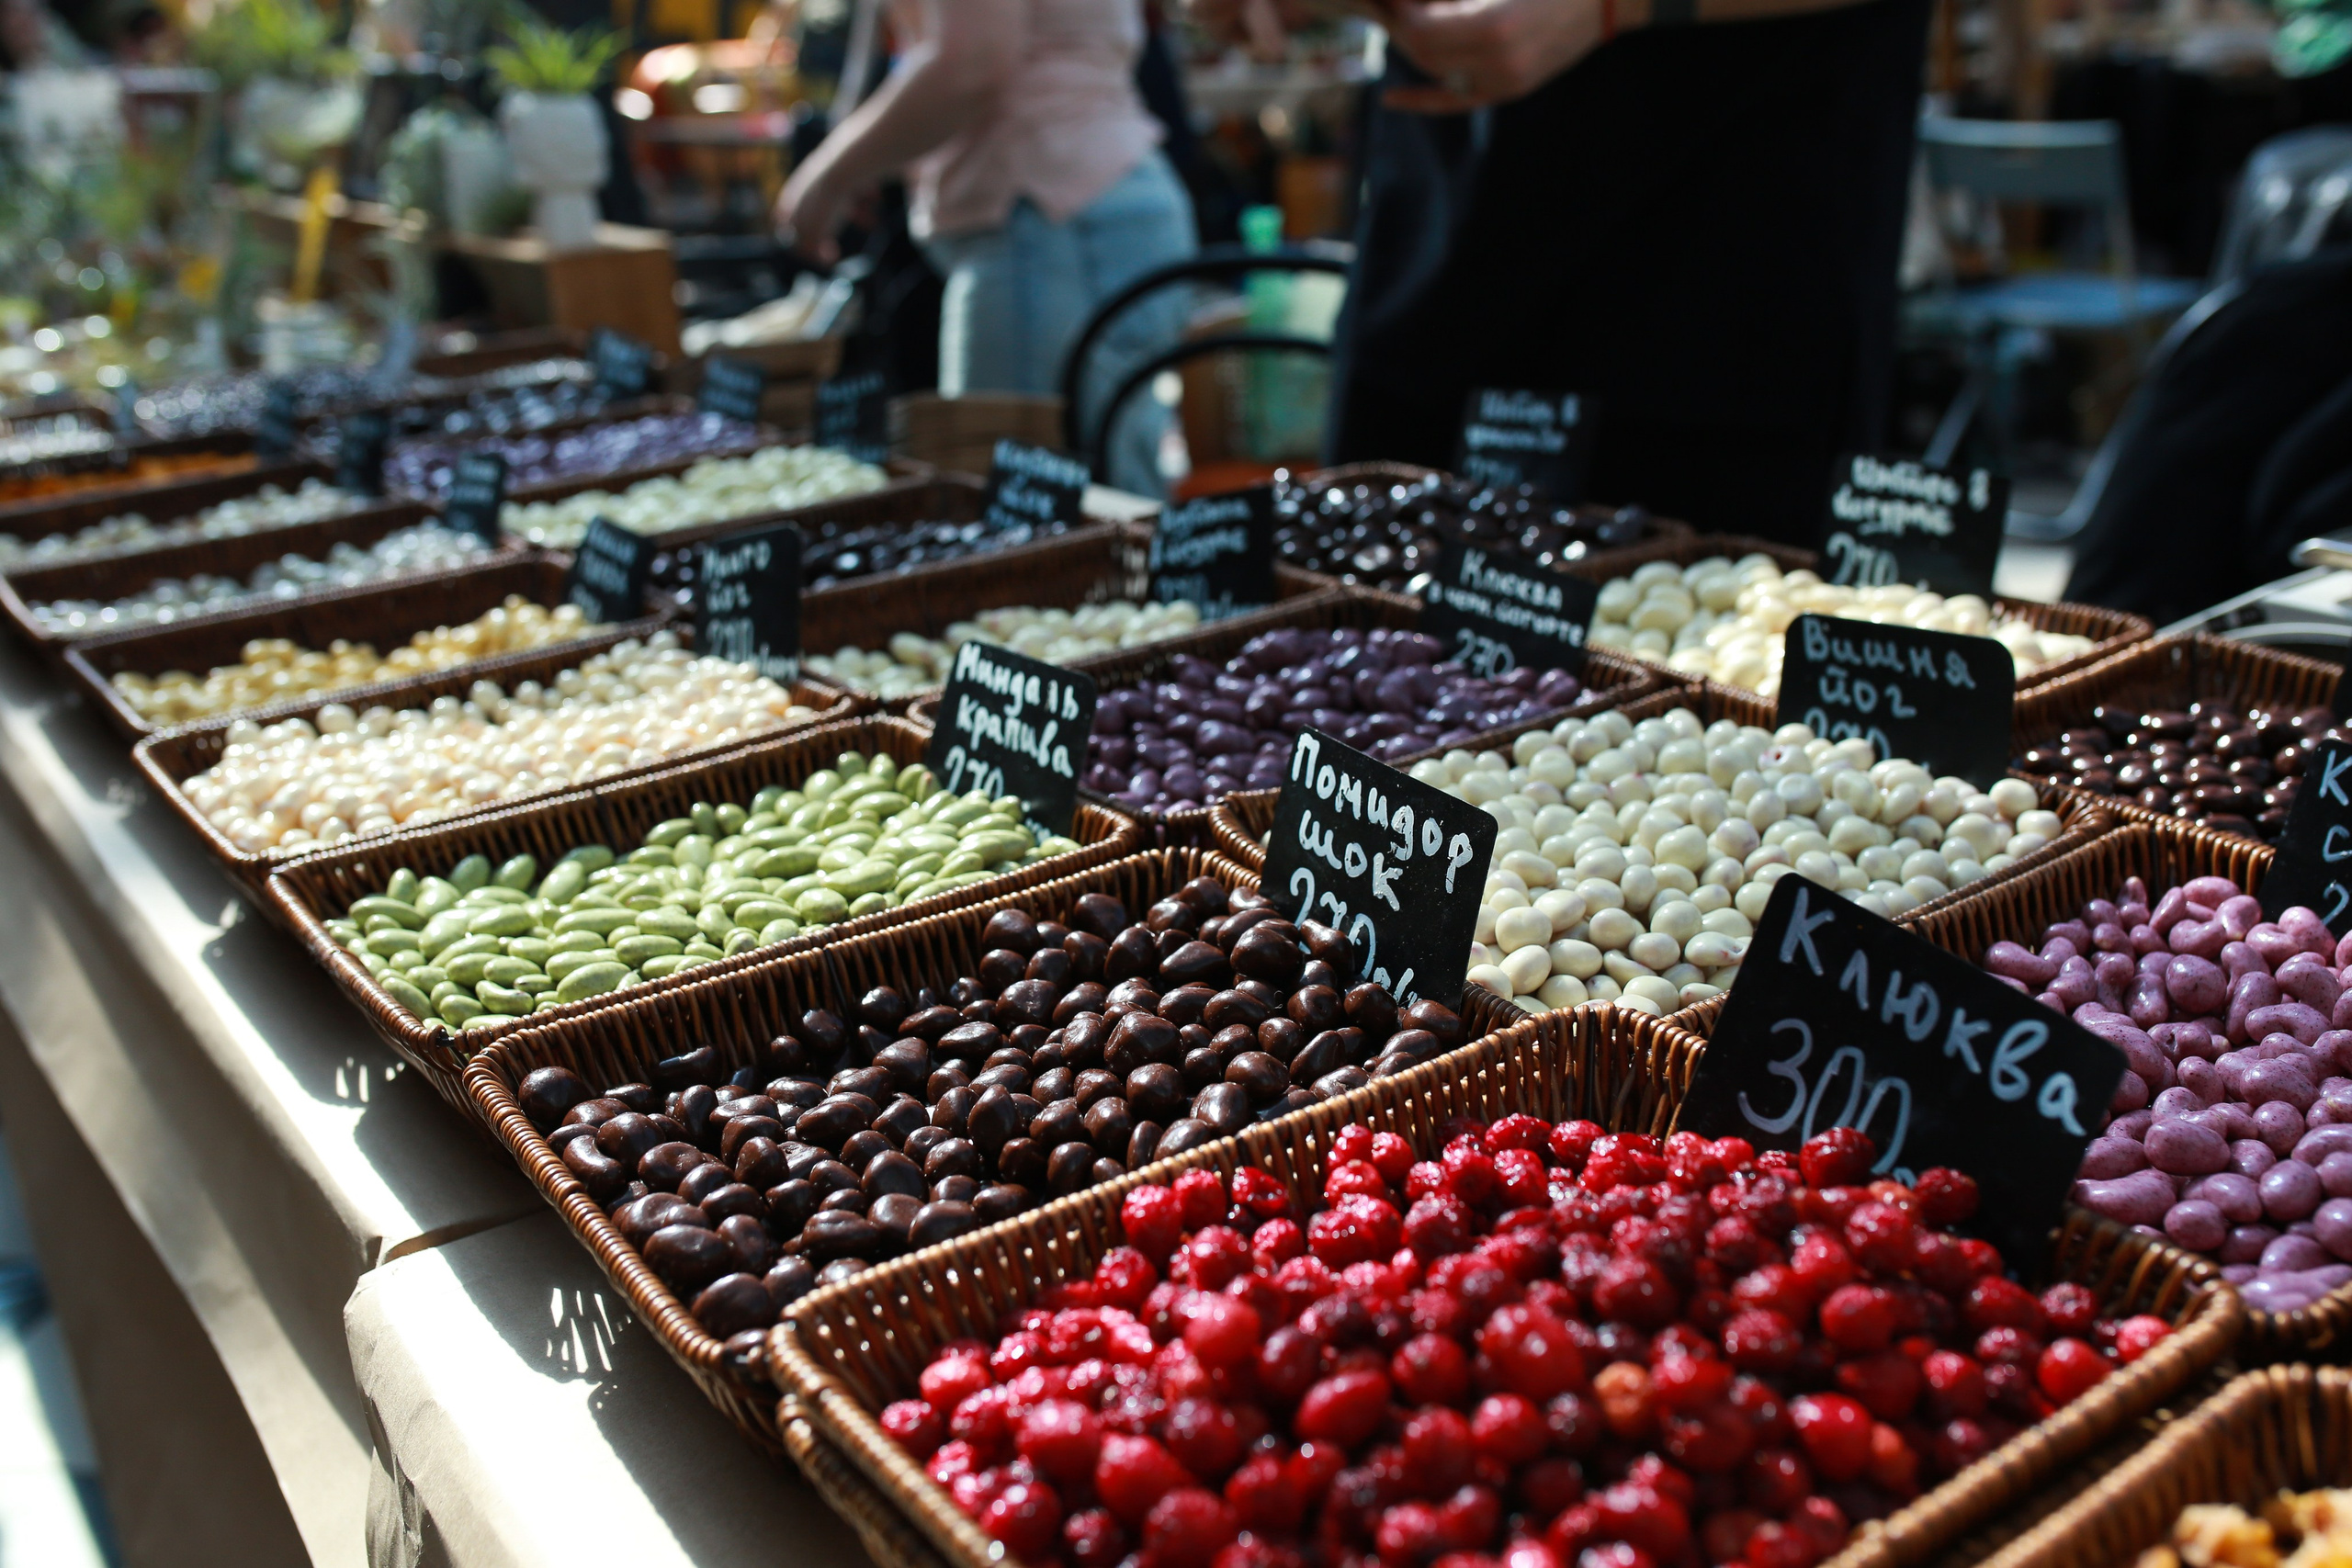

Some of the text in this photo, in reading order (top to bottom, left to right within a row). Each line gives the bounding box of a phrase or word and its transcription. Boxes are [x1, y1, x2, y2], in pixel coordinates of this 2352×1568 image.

[1292, 733, 1473, 893] Помидор
[1780, 887, 2086, 1136] Клюква
[1738, 1019, 1911, 1174] 300
